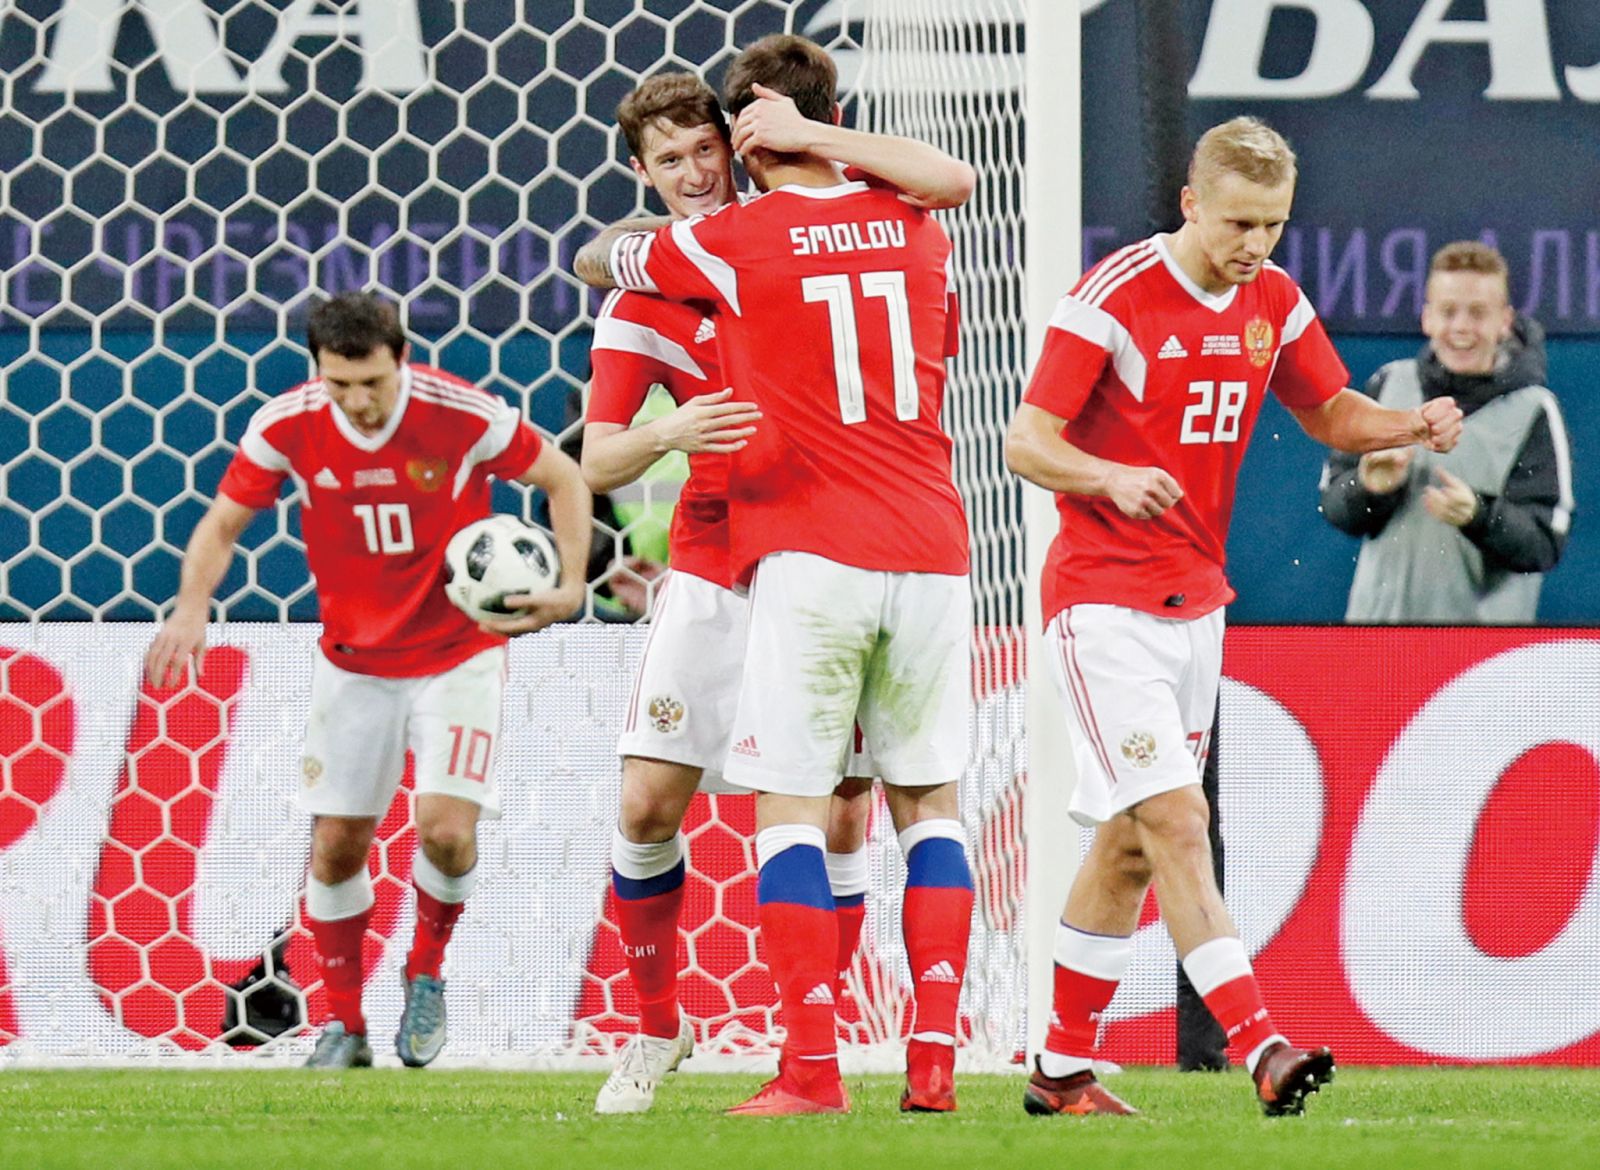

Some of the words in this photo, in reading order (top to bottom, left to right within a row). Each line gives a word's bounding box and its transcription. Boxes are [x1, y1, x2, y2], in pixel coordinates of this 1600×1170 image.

[789, 220, 906, 255] SMOLOV
[801, 270, 919, 424] 11
[1180, 380, 1248, 444] 28
[352, 503, 415, 555] 10
[447, 725, 493, 785] 10
